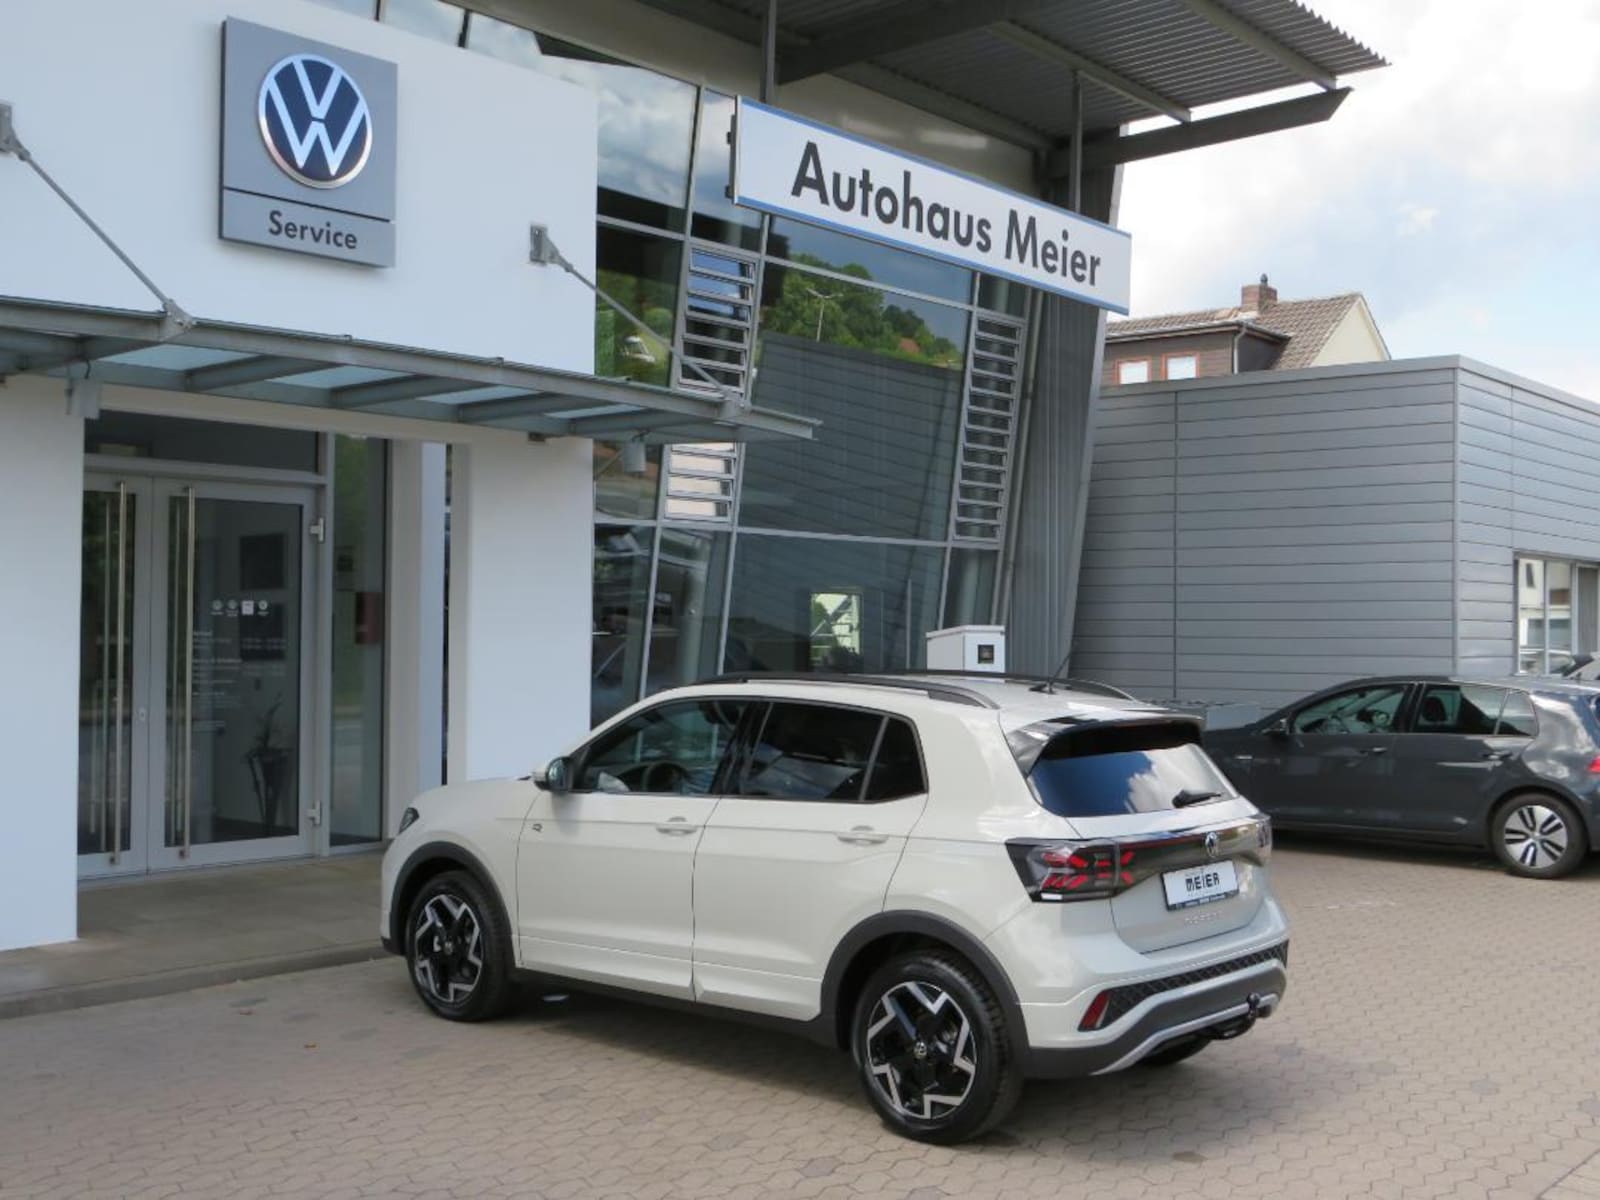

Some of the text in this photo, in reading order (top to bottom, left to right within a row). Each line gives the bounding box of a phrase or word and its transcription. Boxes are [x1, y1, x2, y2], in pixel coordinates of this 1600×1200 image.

[265, 57, 367, 177] VW
[268, 209, 358, 250] Service
[791, 140, 1101, 287] Autohaus Meier
